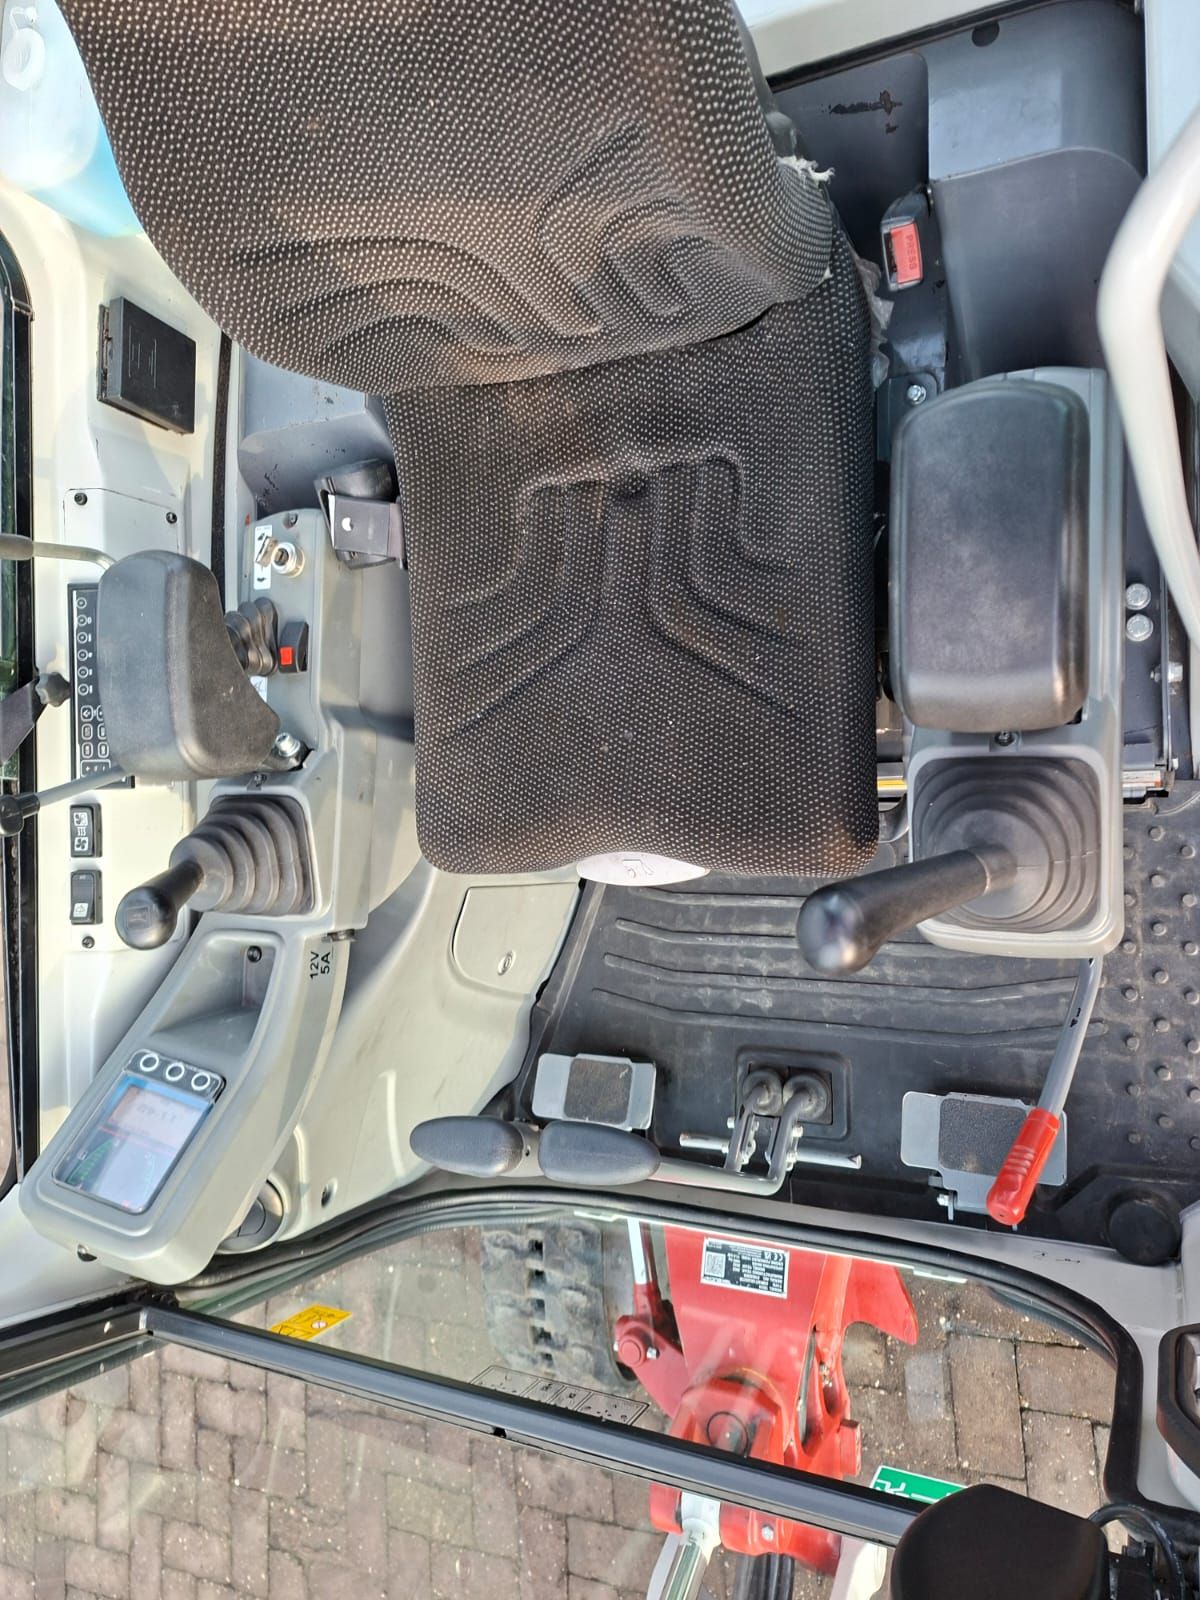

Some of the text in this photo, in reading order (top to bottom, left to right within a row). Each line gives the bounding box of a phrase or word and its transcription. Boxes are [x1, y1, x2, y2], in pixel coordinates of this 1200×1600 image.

[905, 233, 917, 271] PRESS
[309, 950, 319, 980] 12V
[320, 951, 331, 975] 5A
